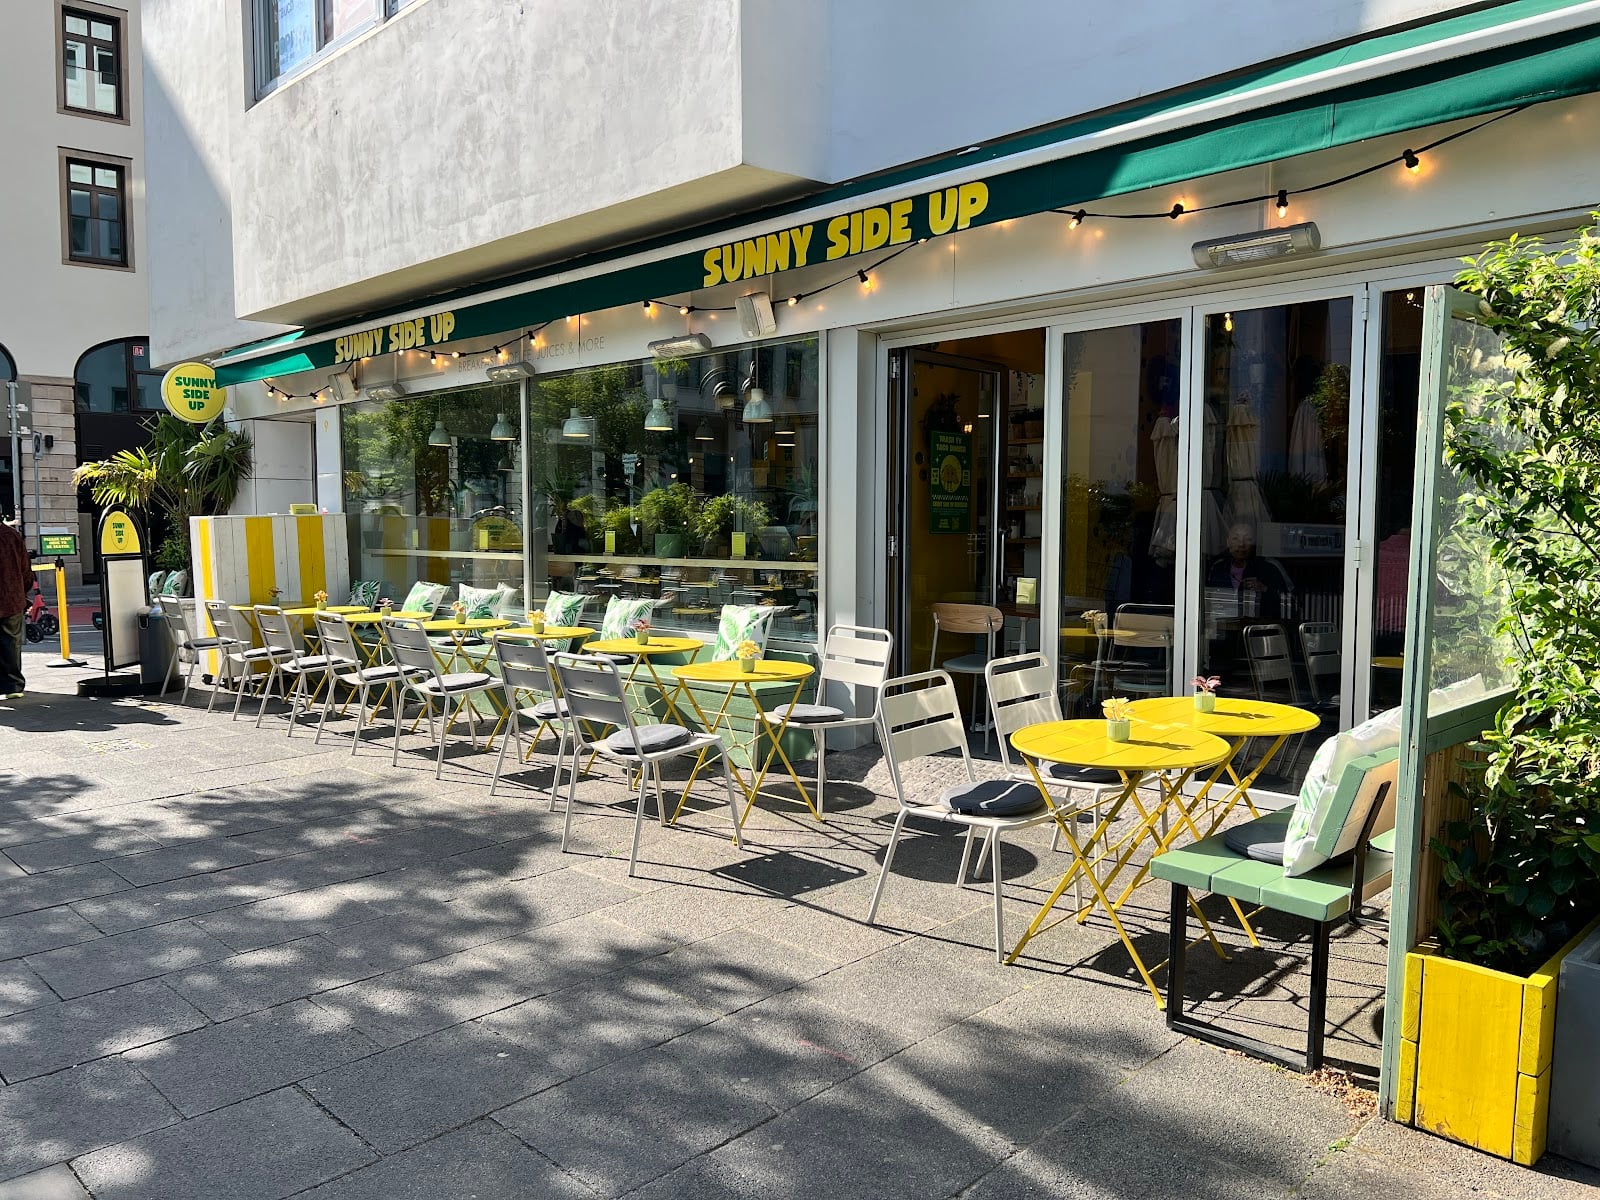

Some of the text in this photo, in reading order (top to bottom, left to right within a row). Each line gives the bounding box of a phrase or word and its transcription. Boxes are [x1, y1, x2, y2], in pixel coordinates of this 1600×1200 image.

[703, 181, 989, 288] SUNNY SIDE UP
[334, 311, 456, 364] SUNNY SIDE UP
[579, 335, 605, 353] MORE
[175, 376, 216, 388] SUNNY
[183, 389, 210, 400] SIDE
[188, 401, 205, 411] UP
